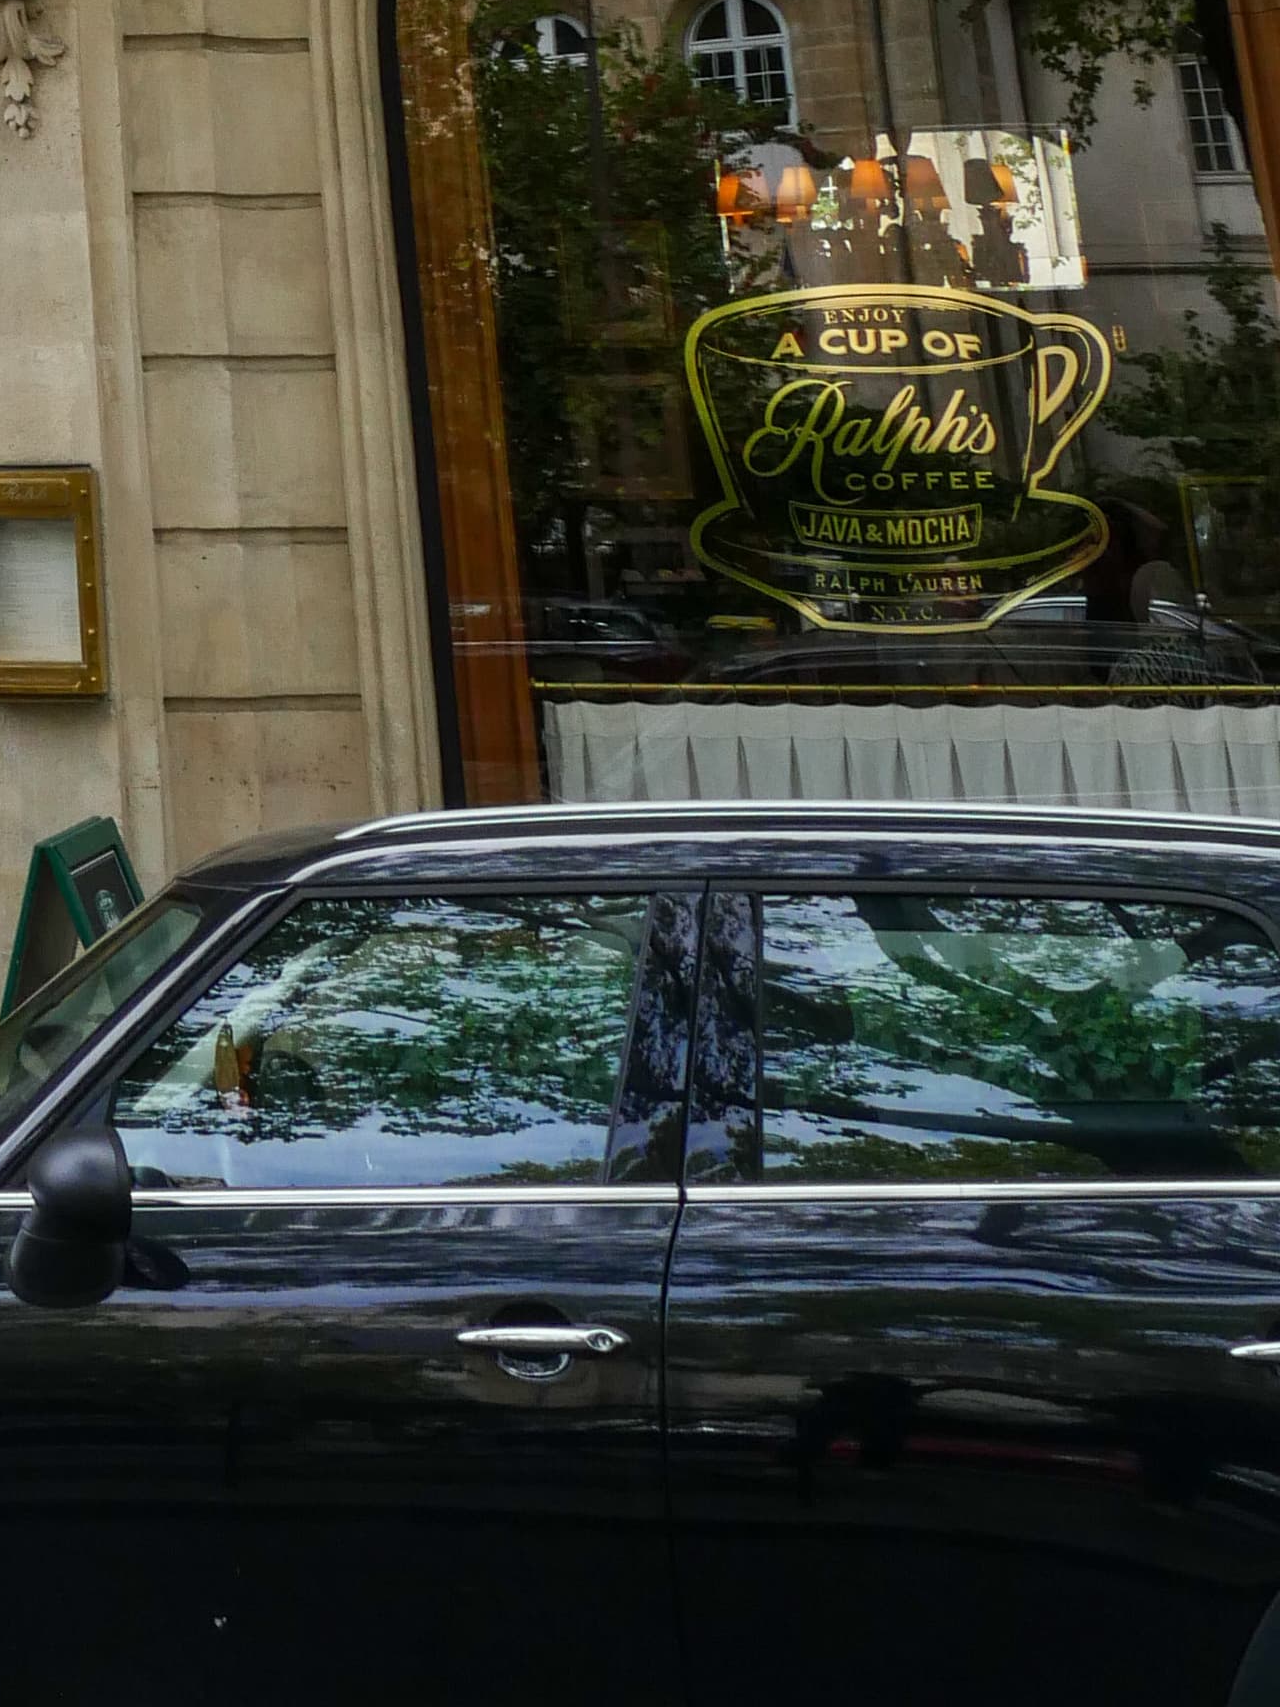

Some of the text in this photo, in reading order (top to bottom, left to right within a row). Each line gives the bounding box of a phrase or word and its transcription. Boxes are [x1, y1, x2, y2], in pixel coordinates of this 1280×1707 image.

[823, 307, 906, 326] ENJOY
[771, 329, 984, 360] A CUP OF
[743, 378, 997, 505] Ralph's
[845, 471, 996, 491] COFFEE
[815, 573, 983, 593] RALPH LAUREN
